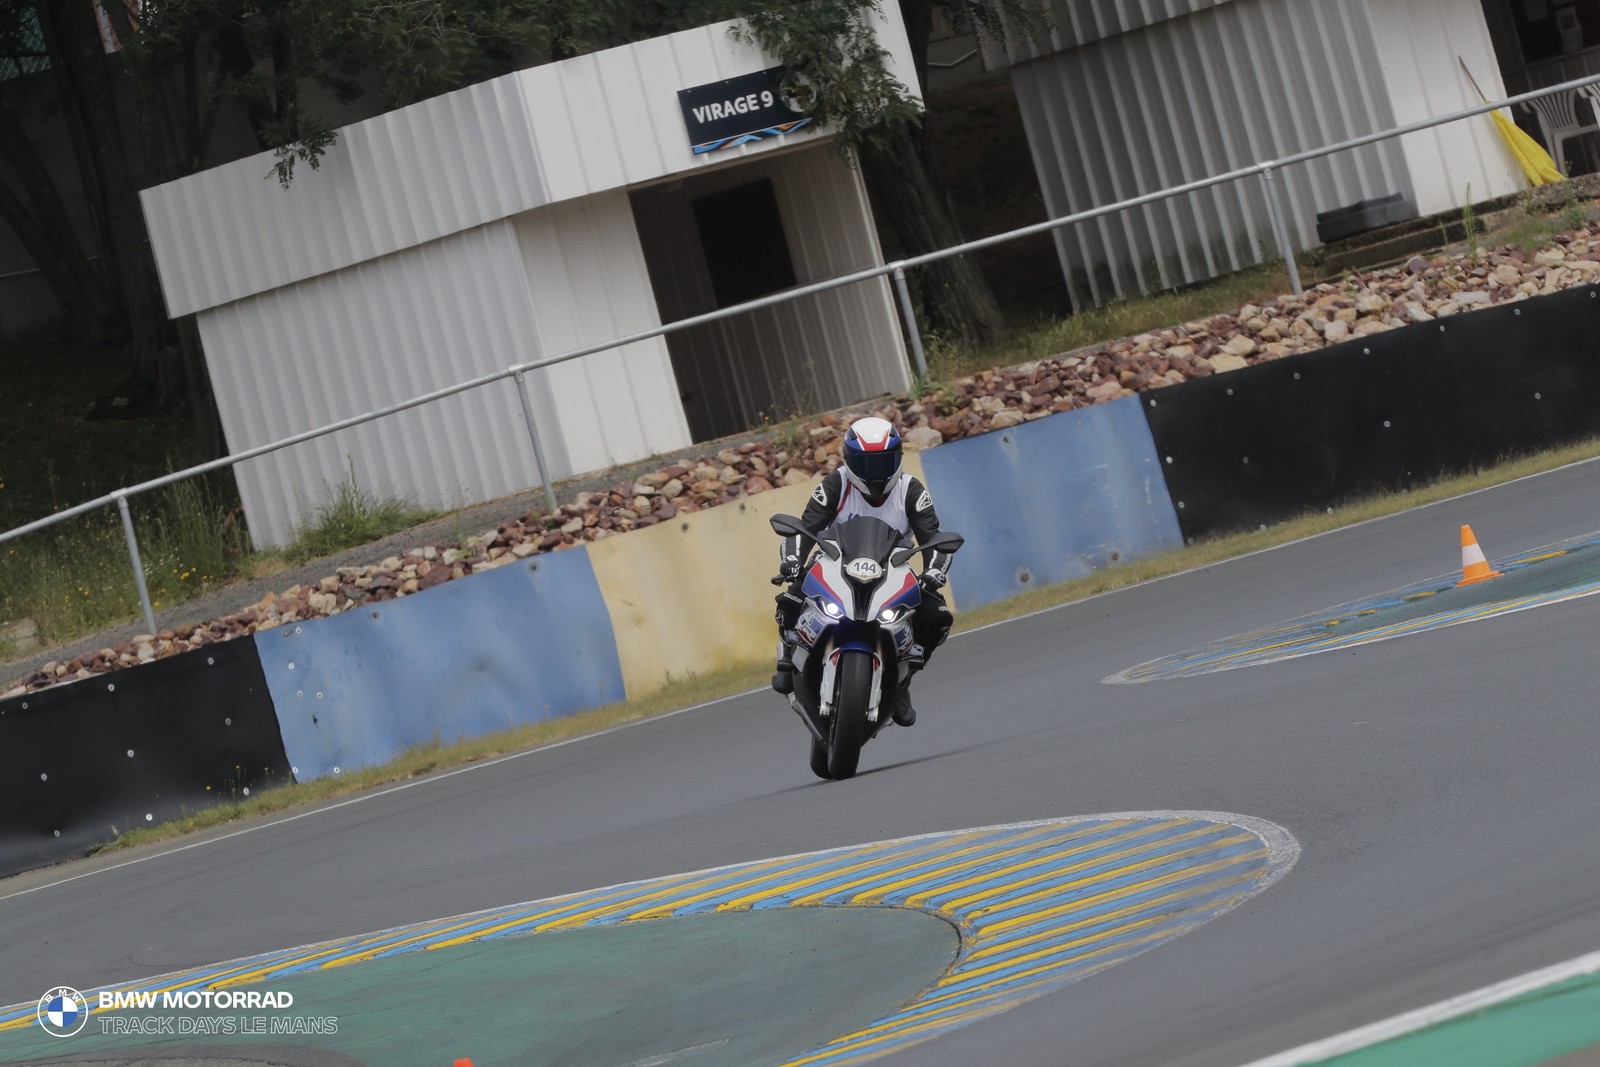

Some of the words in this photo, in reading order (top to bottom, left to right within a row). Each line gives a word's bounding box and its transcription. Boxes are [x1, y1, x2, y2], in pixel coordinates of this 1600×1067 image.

[692, 94, 760, 124] VIRAGE
[760, 90, 774, 108] 9
[854, 561, 877, 574] 144
